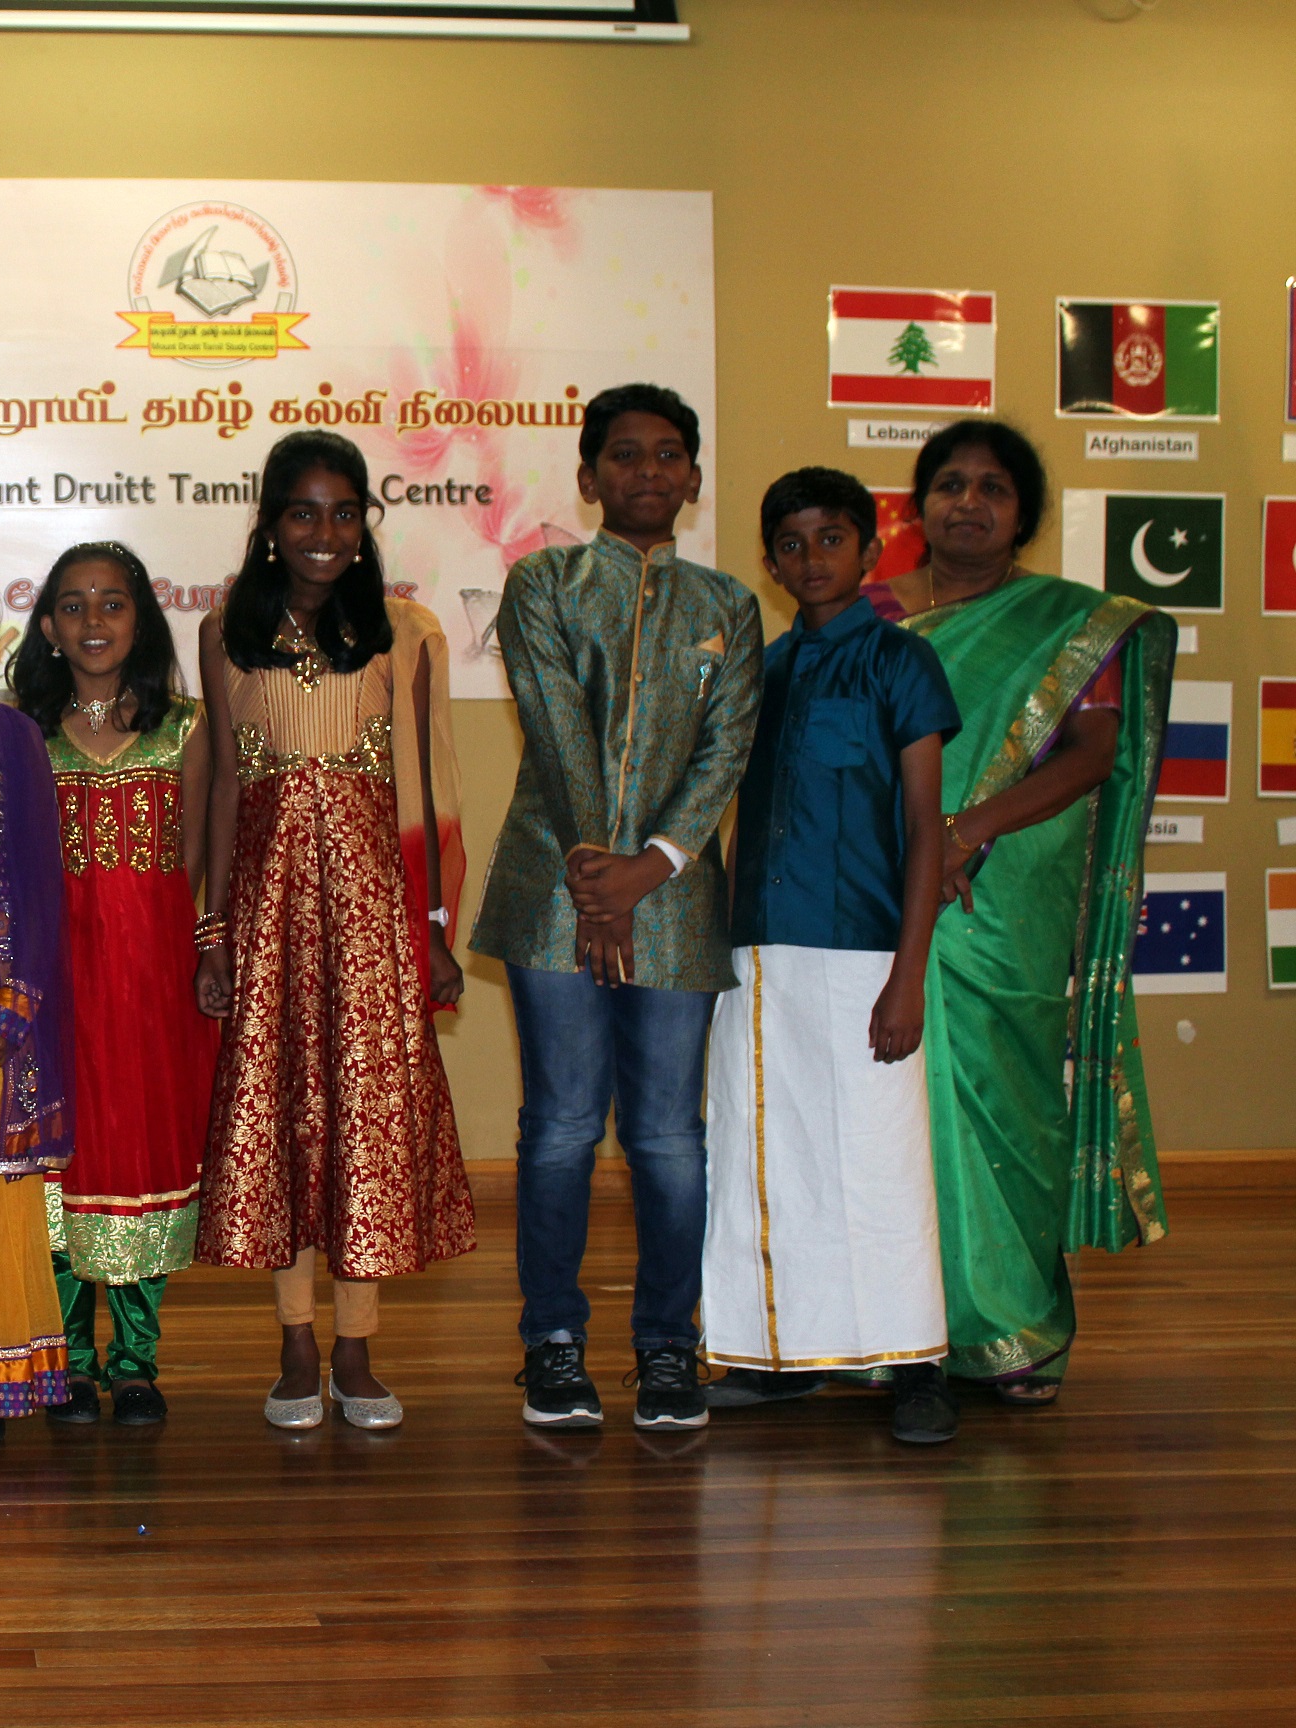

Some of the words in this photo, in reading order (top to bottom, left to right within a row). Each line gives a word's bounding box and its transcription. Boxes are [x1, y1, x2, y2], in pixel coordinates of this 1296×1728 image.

[140, 381, 253, 438] தமிழ்
[269, 381, 387, 426] கல்வி
[396, 384, 586, 434] நிலையம்
[1091, 436, 1193, 453] Afghanistan
[54, 471, 155, 504] Druitt
[168, 471, 261, 504] Tamil
[380, 474, 493, 505] Centre
